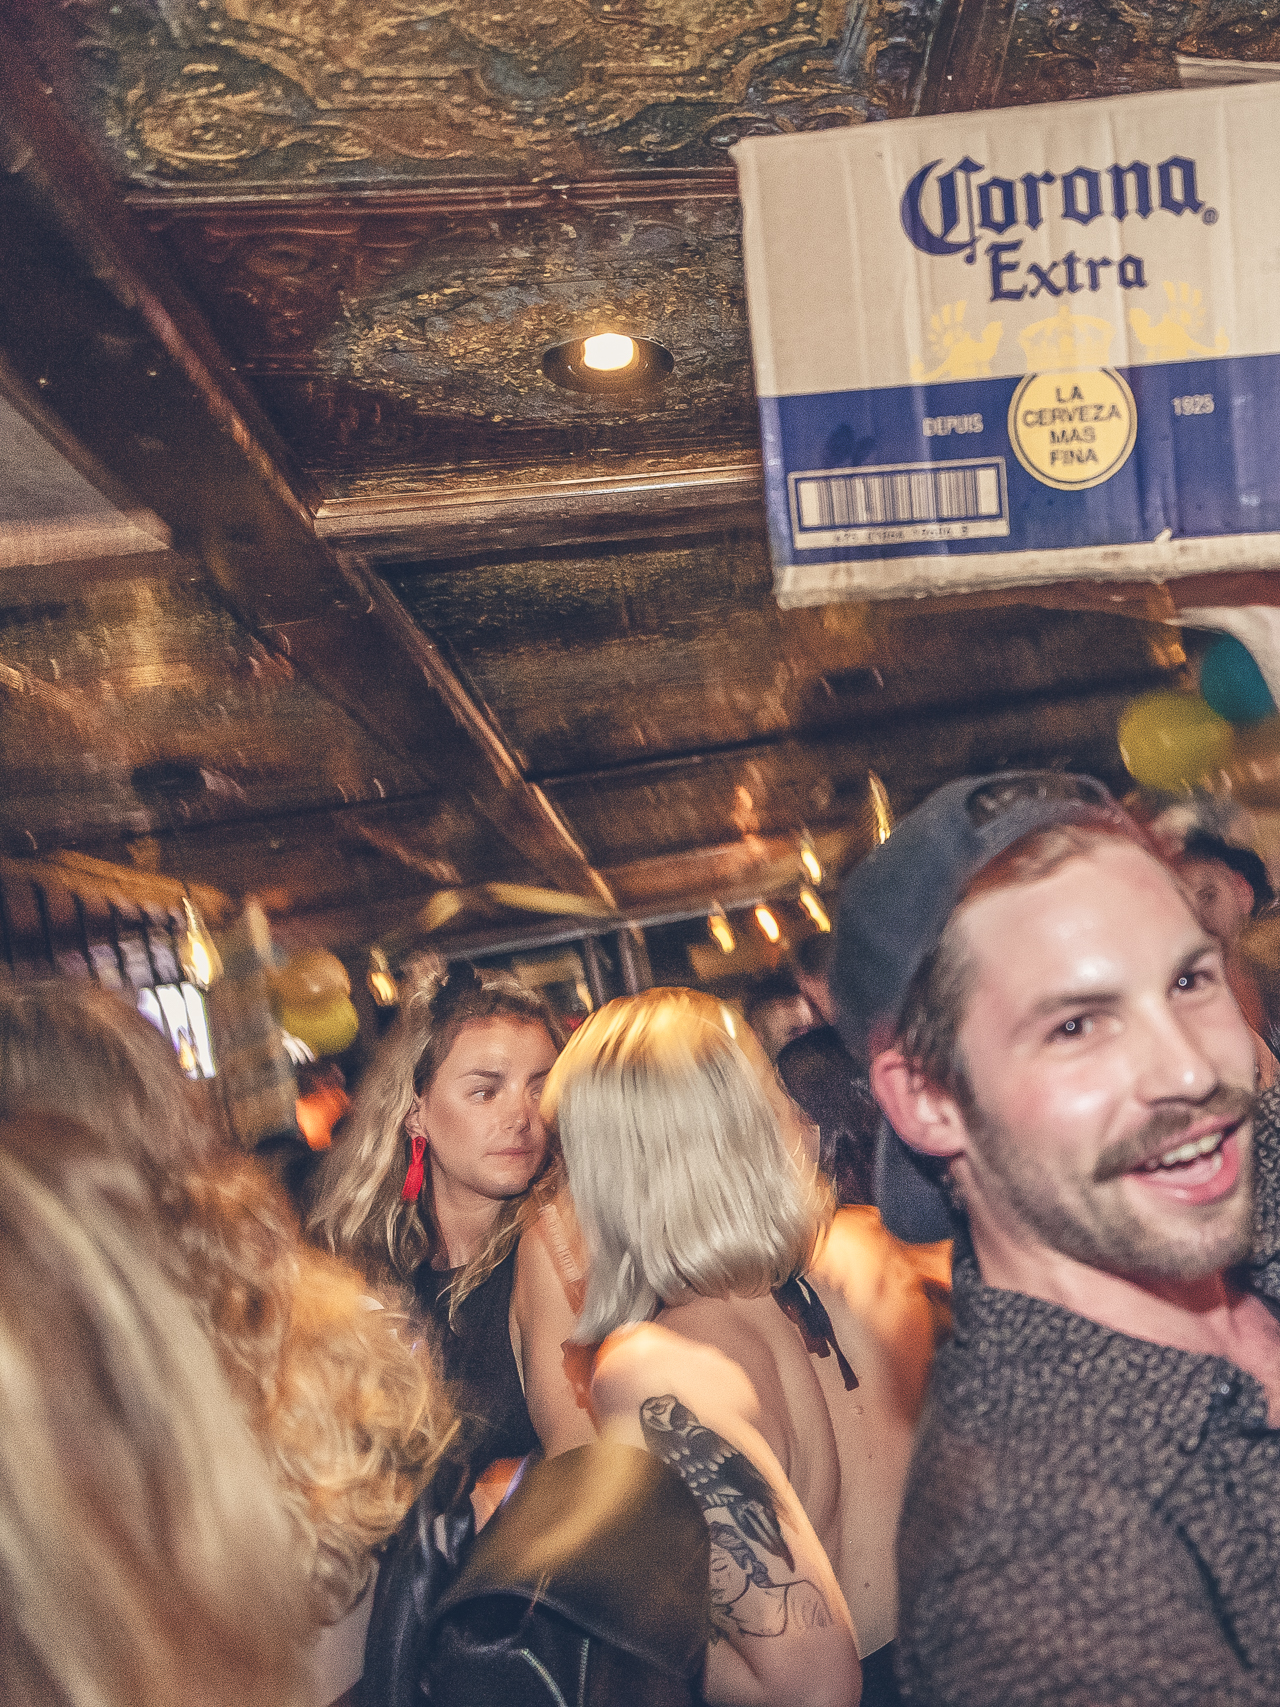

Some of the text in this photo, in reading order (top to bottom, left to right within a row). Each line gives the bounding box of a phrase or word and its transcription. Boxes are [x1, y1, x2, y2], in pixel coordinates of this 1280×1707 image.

[900, 155, 1204, 264] Corona
[985, 238, 1147, 302] Extra
[1055, 385, 1084, 403] LA
[922, 412, 984, 437] DEPUIS
[1022, 404, 1122, 428] CERVEZA
[1049, 425, 1096, 444] MAS
[1049, 448, 1099, 467] FINA
